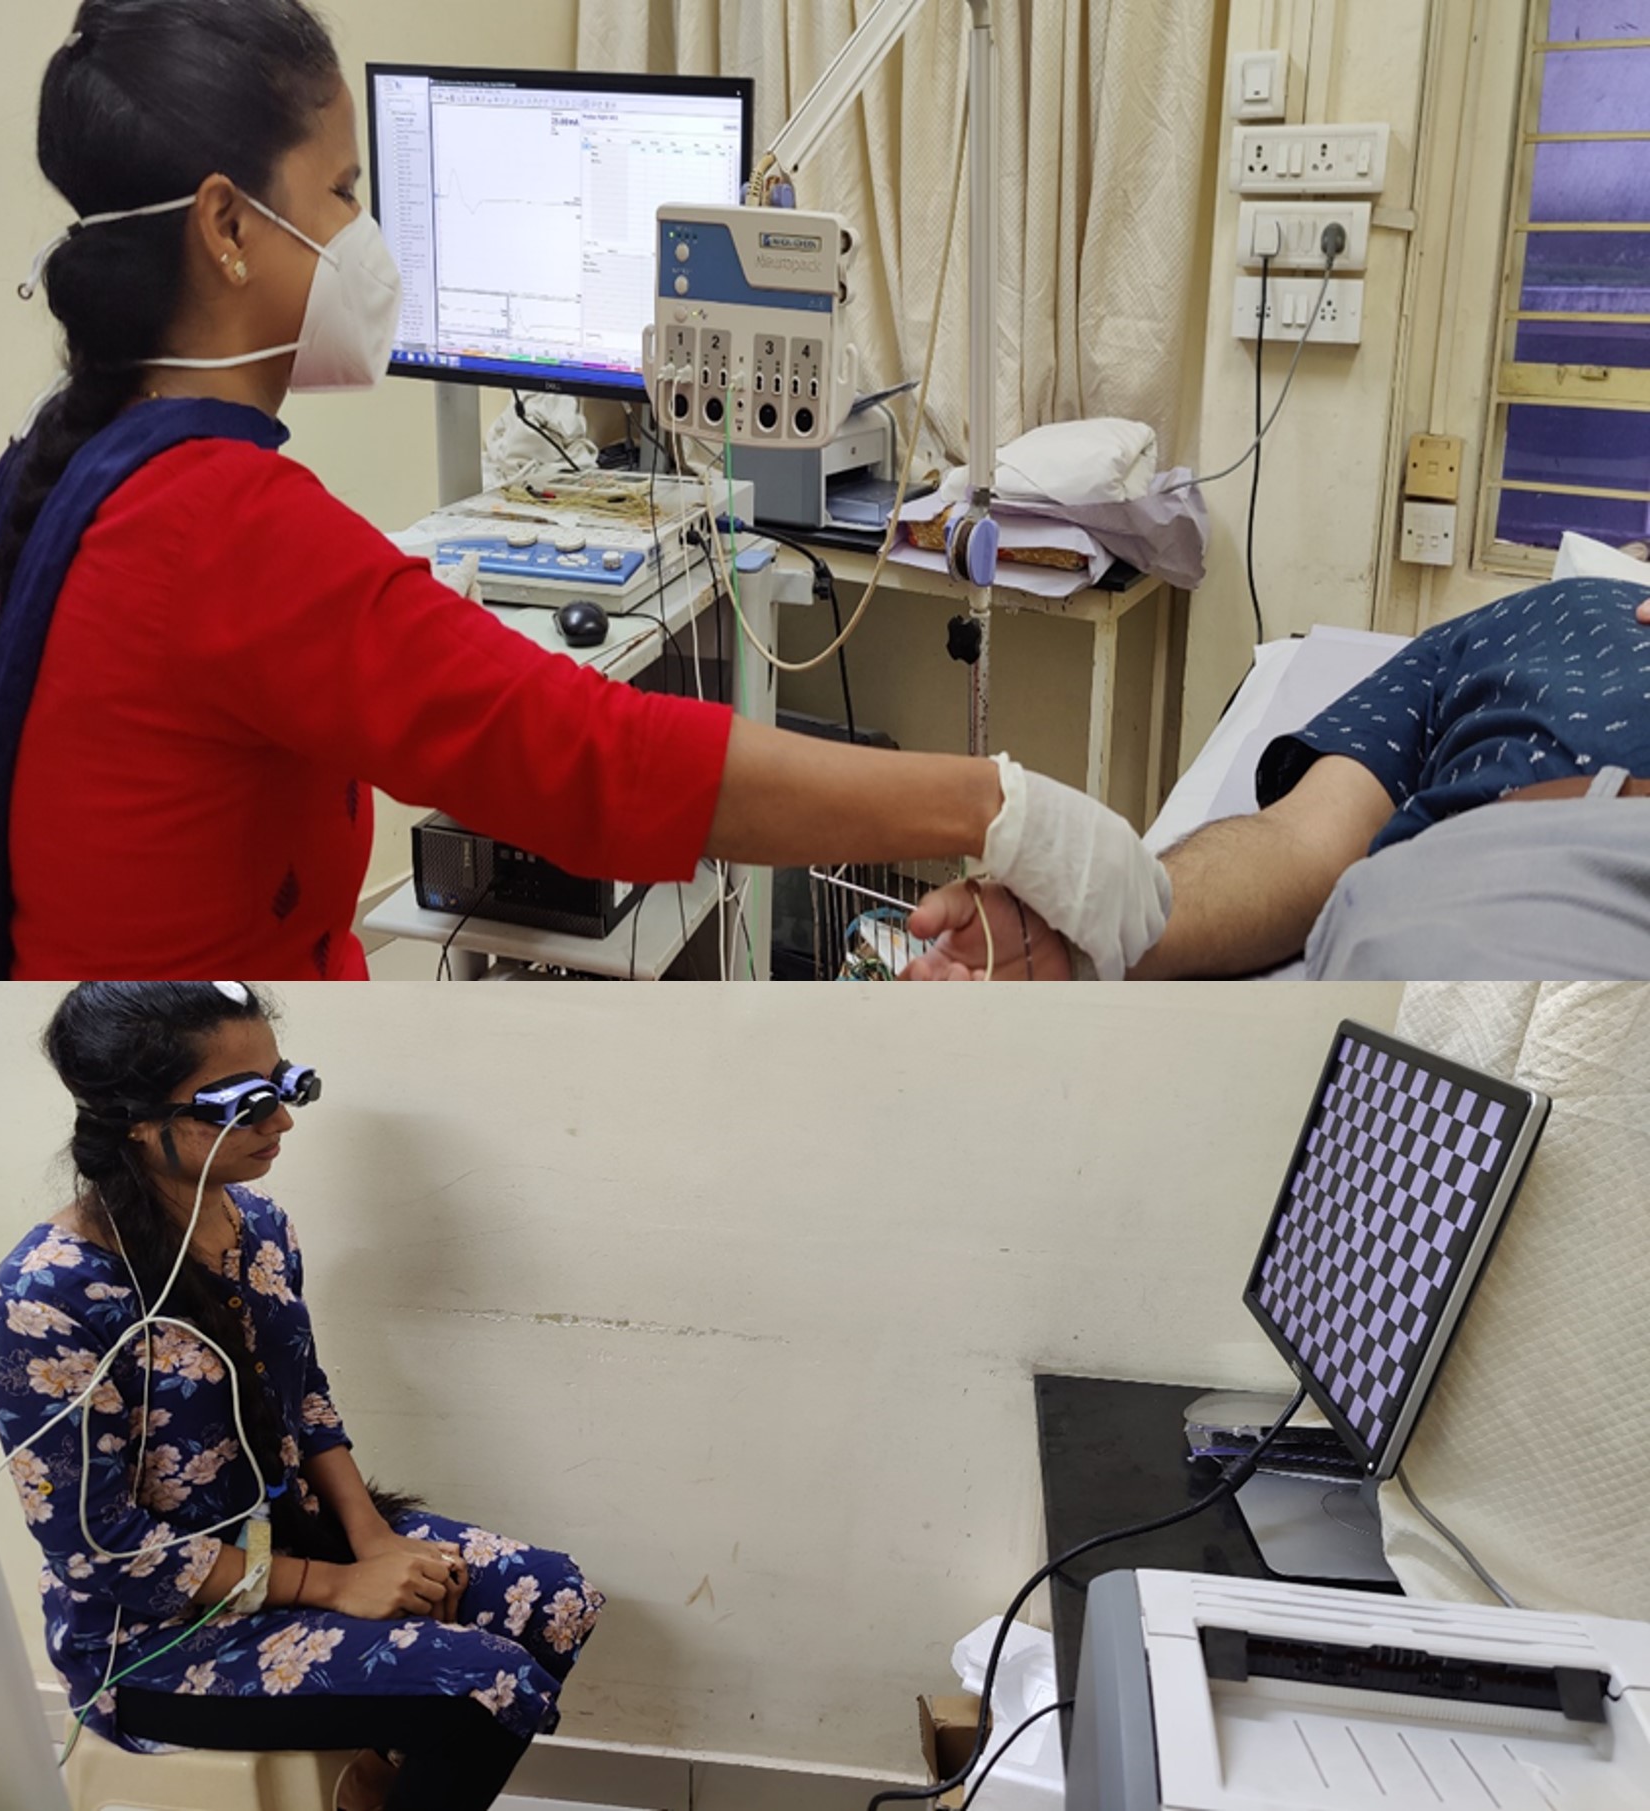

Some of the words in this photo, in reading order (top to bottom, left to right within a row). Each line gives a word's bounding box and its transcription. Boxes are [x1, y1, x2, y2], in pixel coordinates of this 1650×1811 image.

[755, 254, 823, 274] Neuropack
[677, 332, 684, 346] 1
[711, 335, 720, 350] 2
[764, 341, 774, 355] 3
[801, 344, 811, 358] 4
